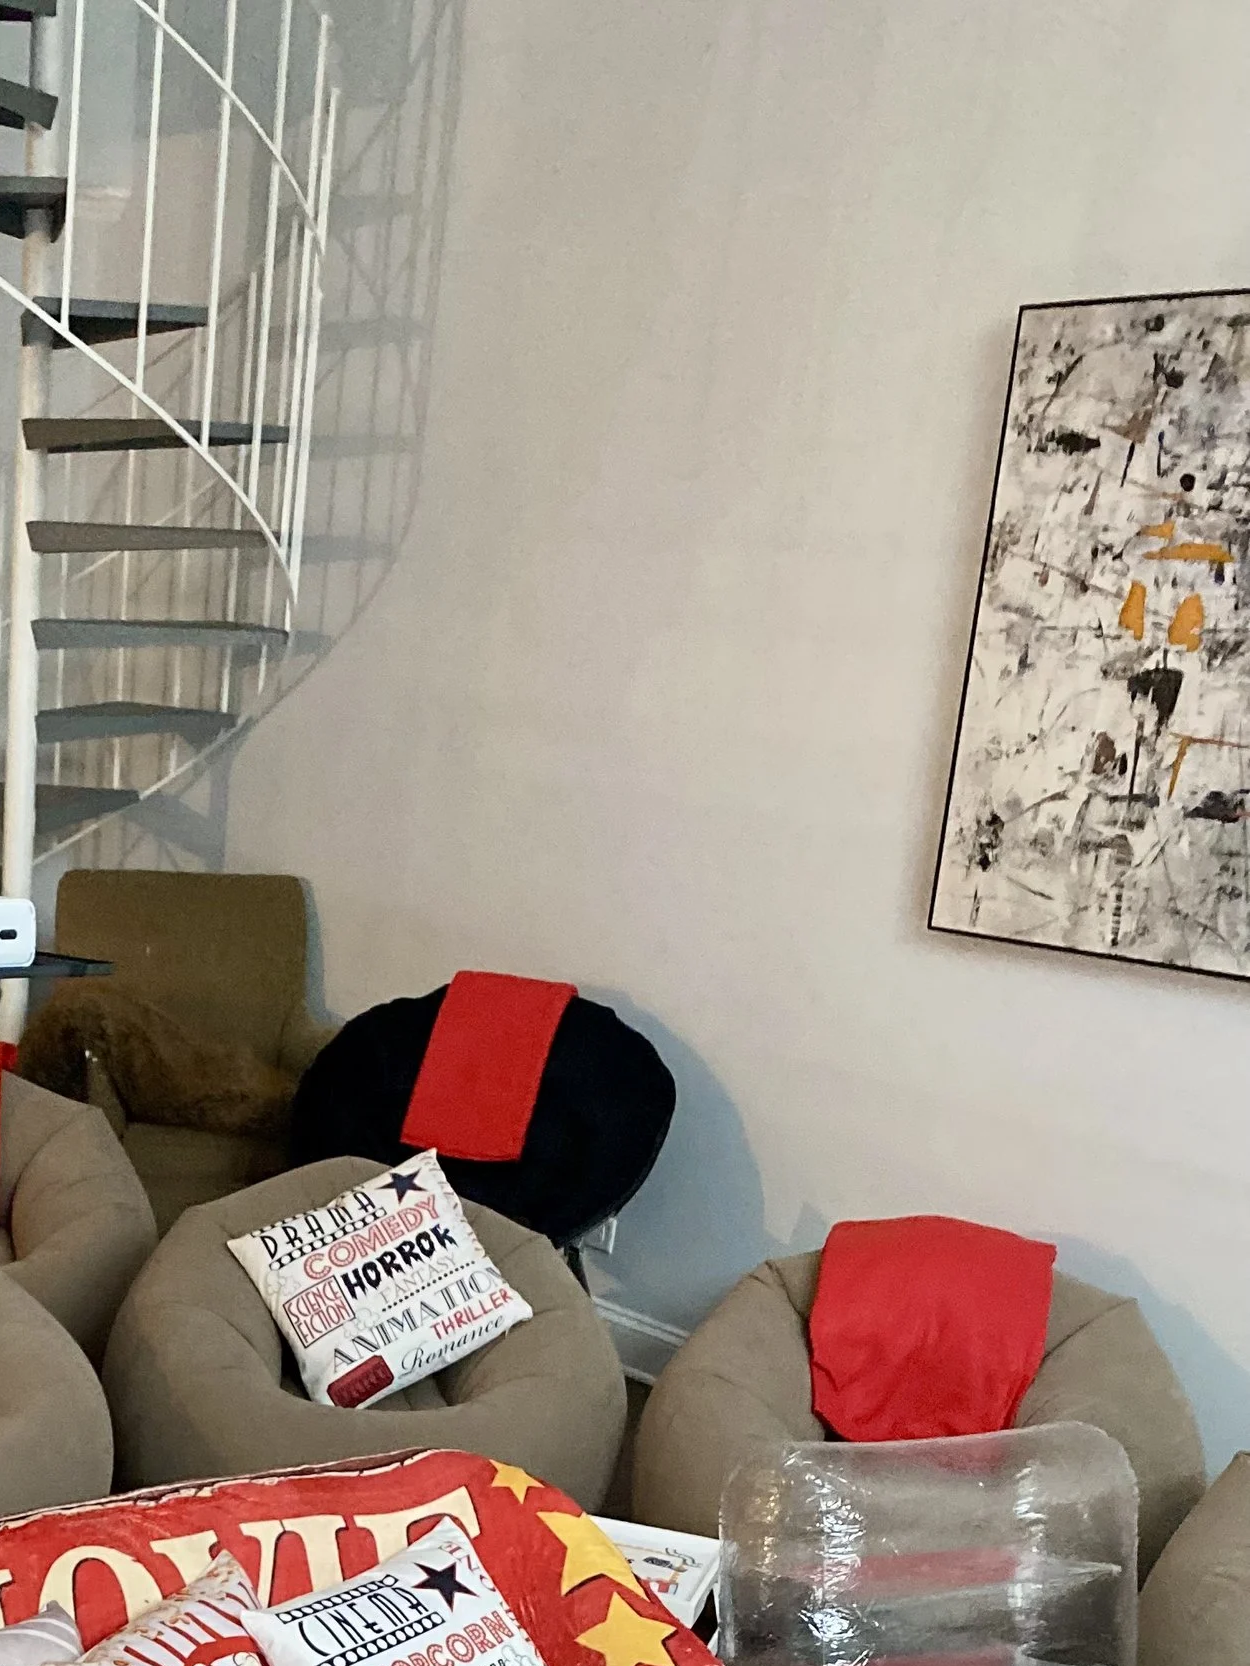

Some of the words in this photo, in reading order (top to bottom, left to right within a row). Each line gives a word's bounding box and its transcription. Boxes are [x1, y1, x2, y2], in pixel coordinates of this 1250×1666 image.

[260, 1190, 377, 1260] DRAMA
[303, 1194, 440, 1280] COMEDY
[340, 1223, 458, 1300] HORROR
[377, 1252, 458, 1304] FANTASY
[286, 1279, 343, 1323] SCIENCE
[296, 1302, 350, 1347] FICTION
[430, 1289, 514, 1341] THRILLER
[400, 1315, 505, 1377] Romance
[298, 1583, 430, 1657] CINEMA
